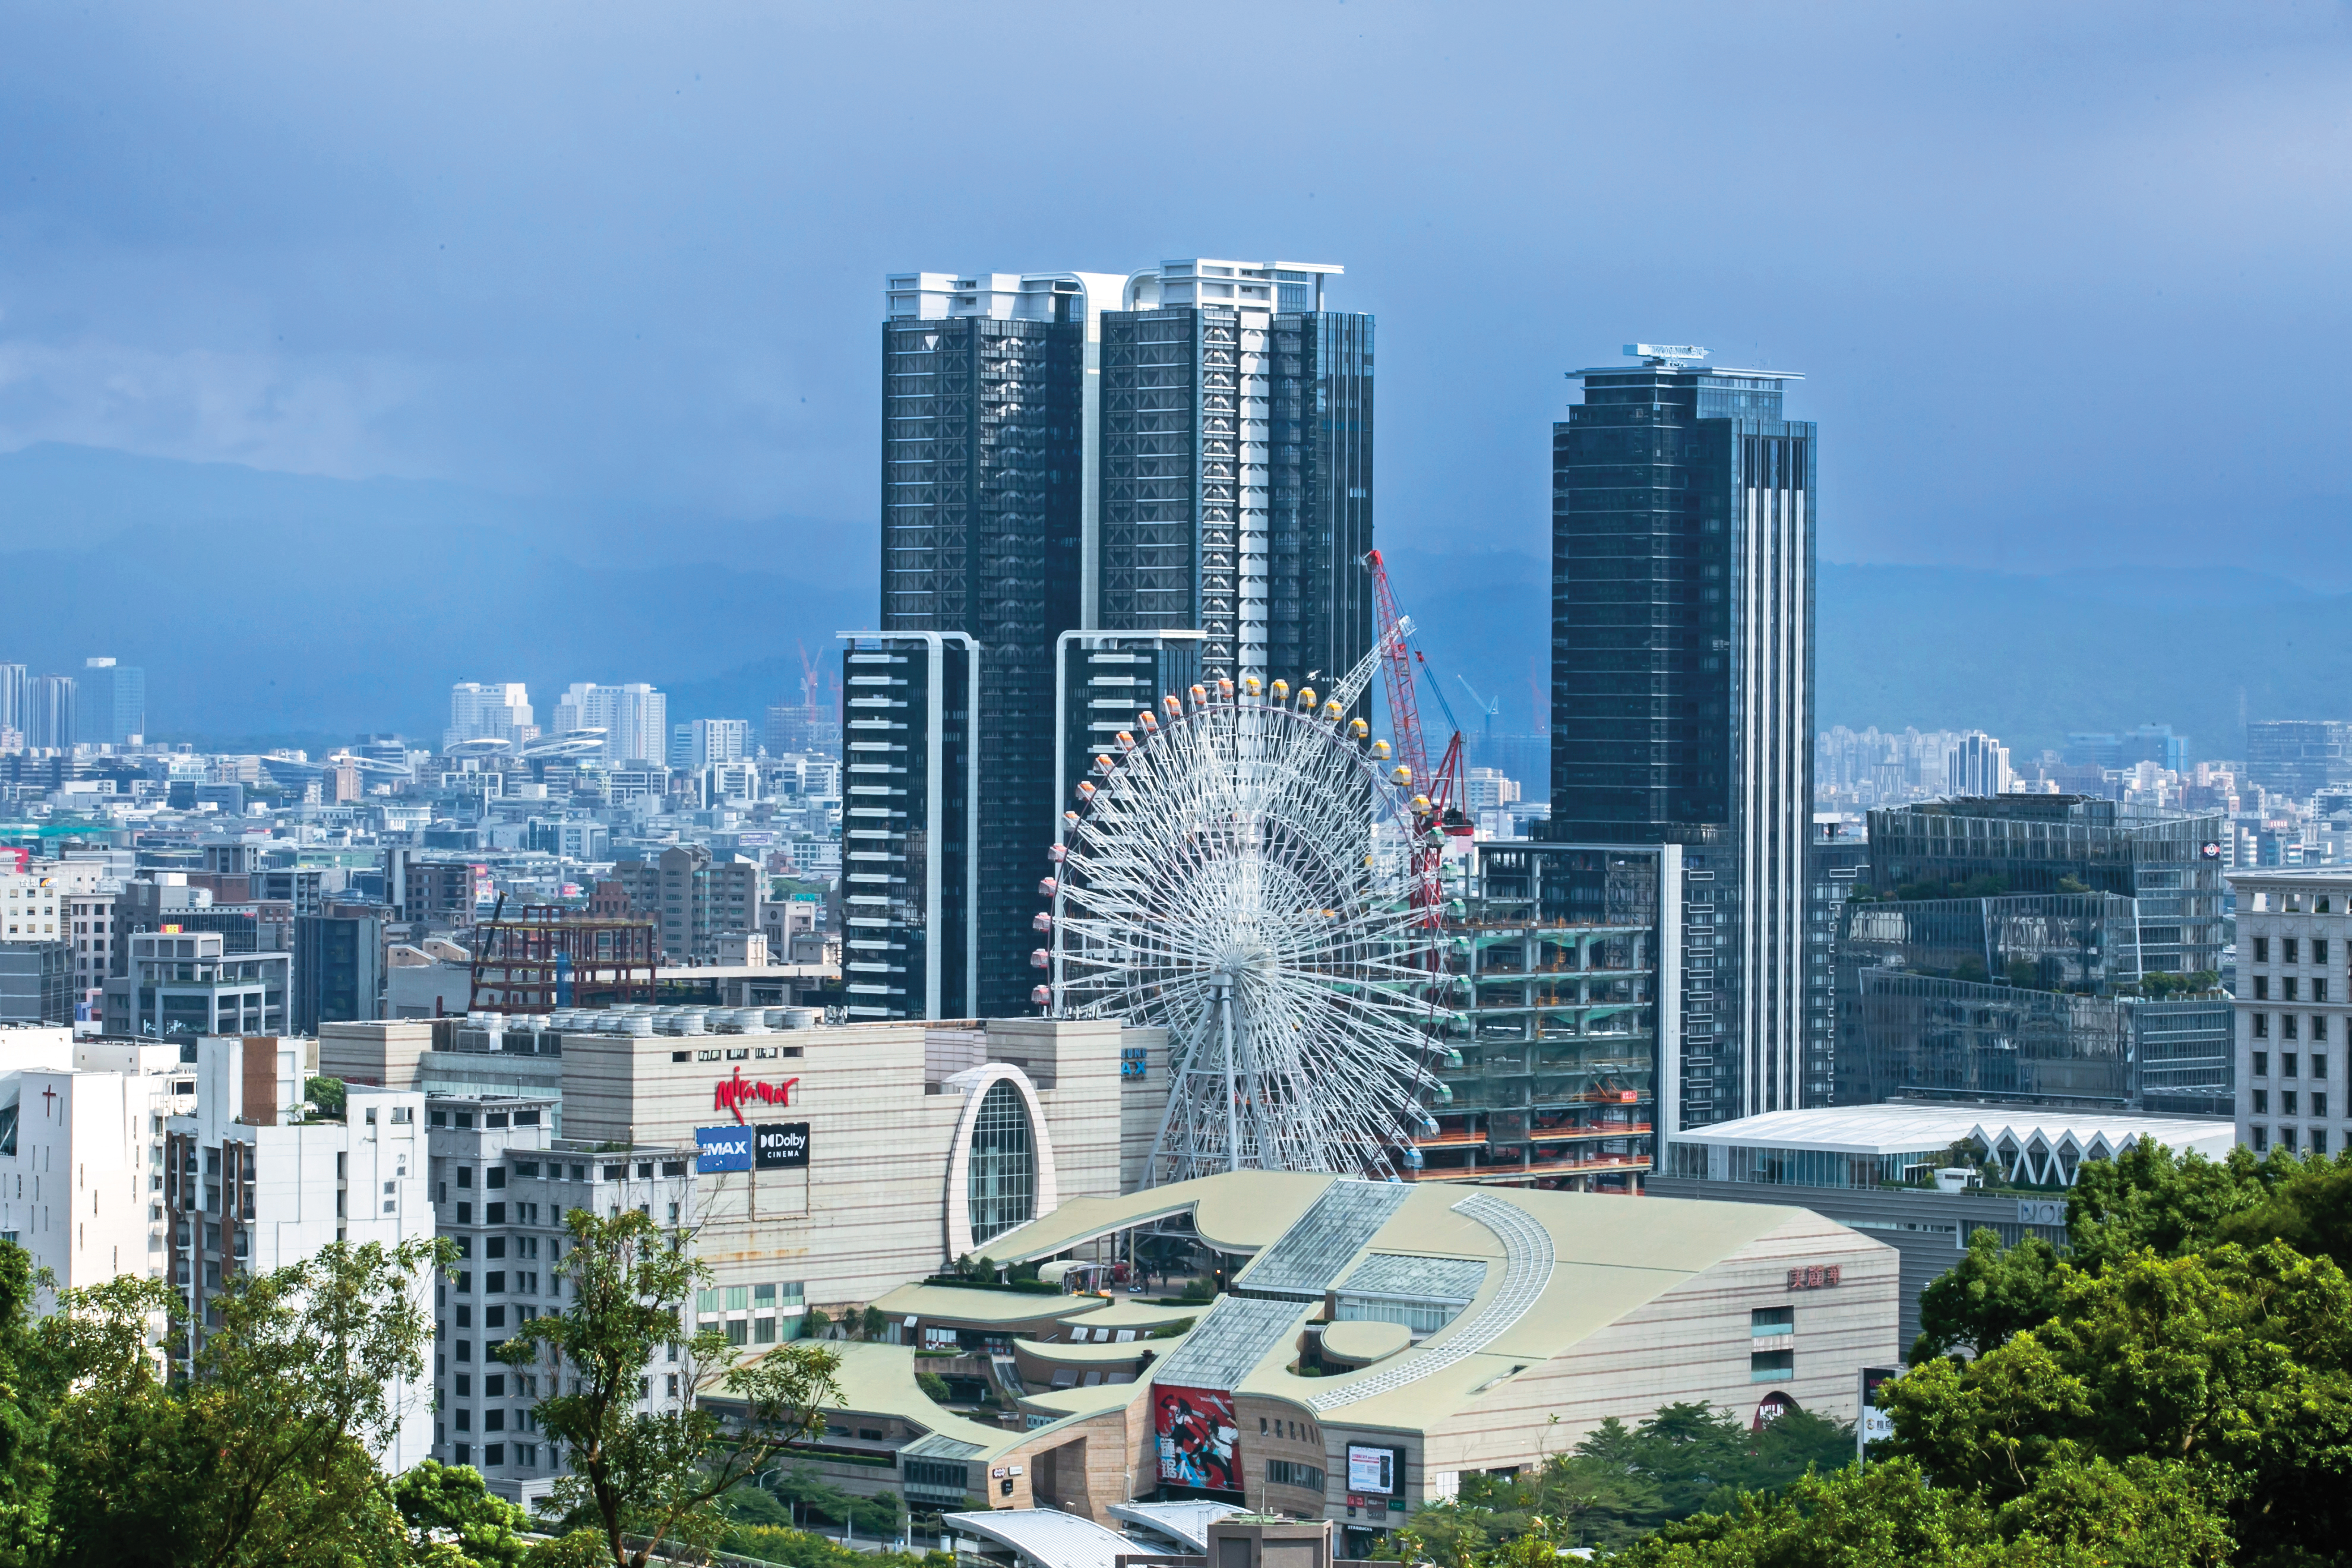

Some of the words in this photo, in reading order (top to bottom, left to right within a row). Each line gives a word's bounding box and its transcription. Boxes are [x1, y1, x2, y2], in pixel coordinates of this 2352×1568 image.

[703, 1141, 746, 1156] IMAX
[776, 1133, 805, 1149] Dolby
[1789, 1264, 1842, 1288] 美麗華
